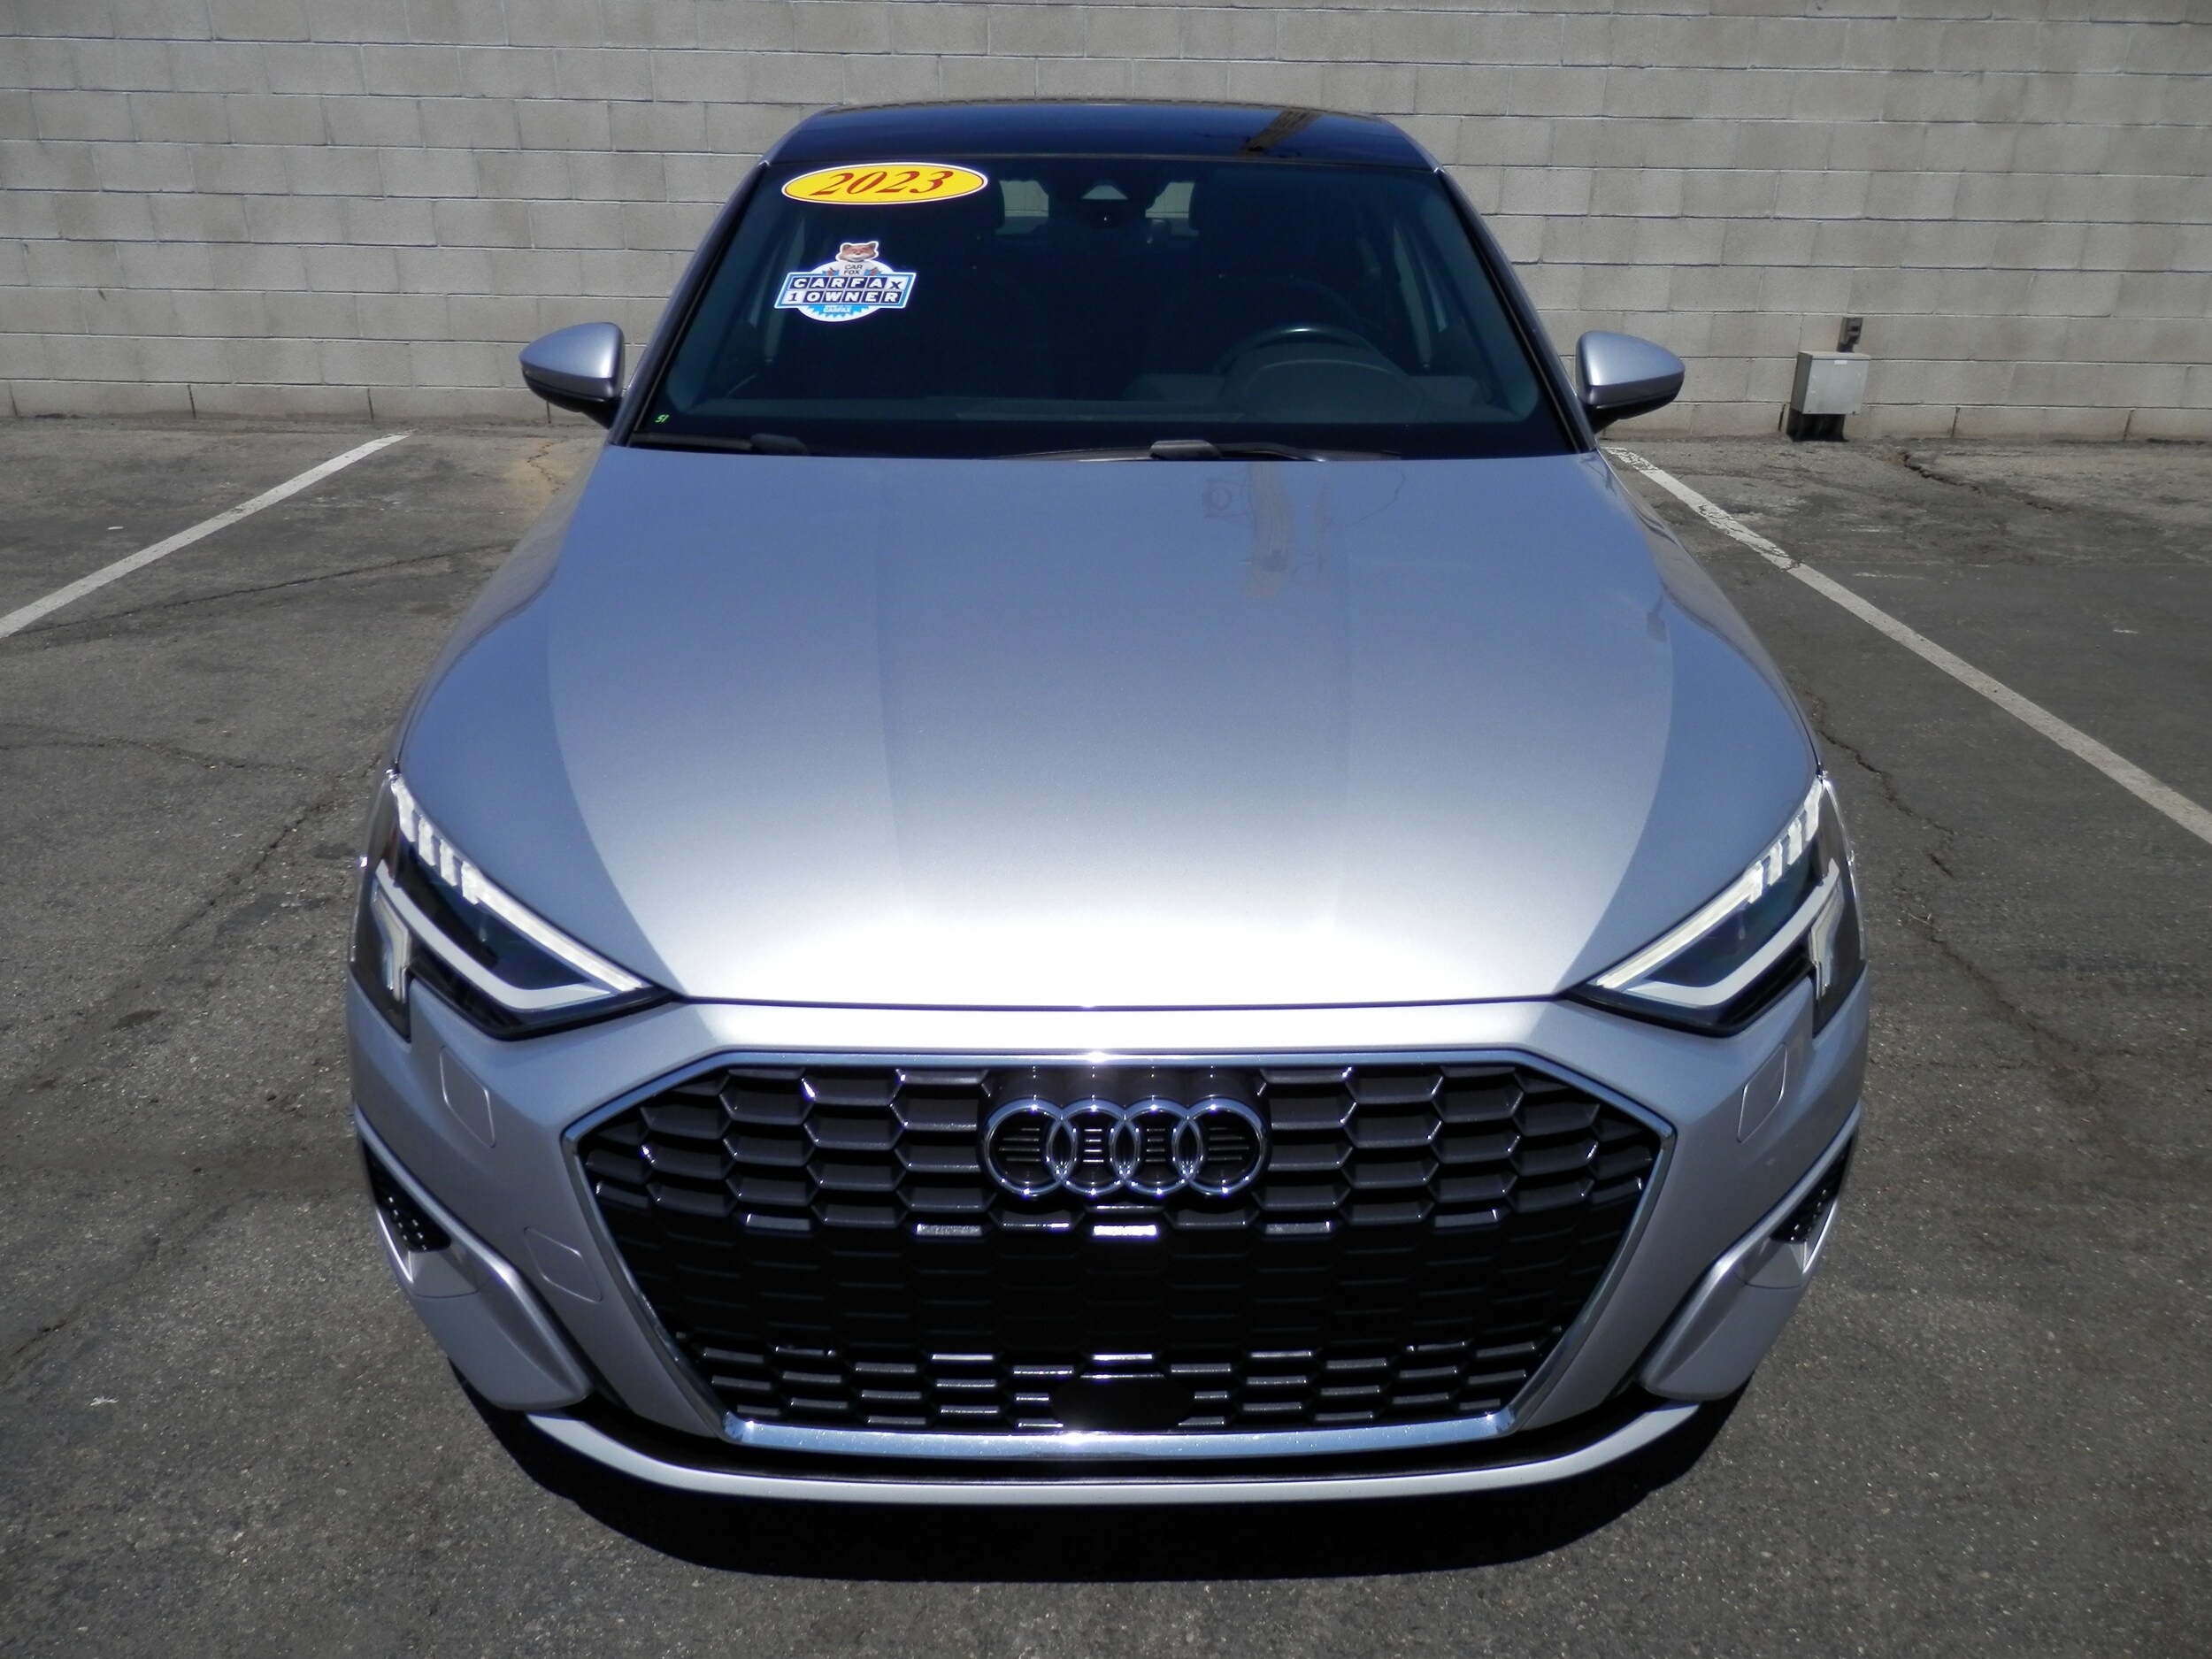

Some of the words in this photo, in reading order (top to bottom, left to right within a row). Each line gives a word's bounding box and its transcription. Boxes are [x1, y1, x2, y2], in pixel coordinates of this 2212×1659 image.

[809, 171, 954, 196] 2023
[793, 278, 902, 289] CARFAX
[787, 292, 798, 302] 1
[806, 292, 898, 303] OWNER
